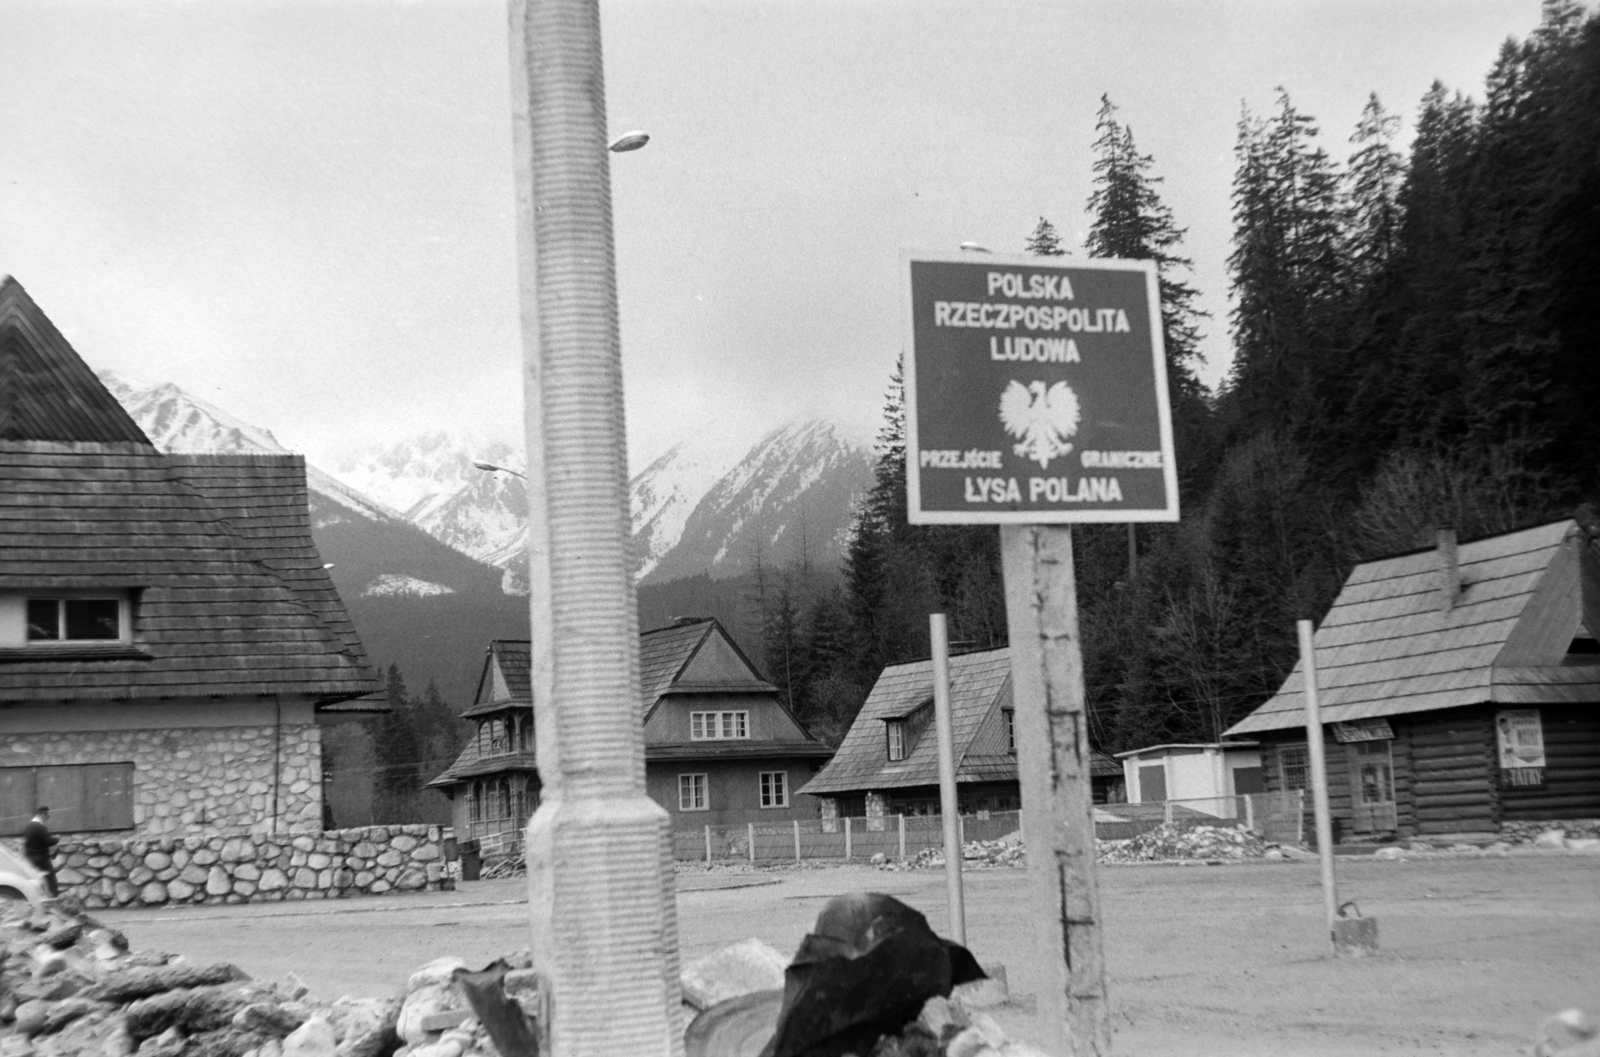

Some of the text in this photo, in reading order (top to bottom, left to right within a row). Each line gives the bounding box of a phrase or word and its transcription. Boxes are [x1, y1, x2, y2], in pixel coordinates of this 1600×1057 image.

[987, 271, 1075, 300] POLSKA
[934, 300, 1131, 333] RZECZPOSPOLITA
[990, 336, 1081, 364] LUDOWA
[920, 447, 1003, 469] PRZEJŚCIE
[965, 476, 1124, 503] ŁYSA POLANA
